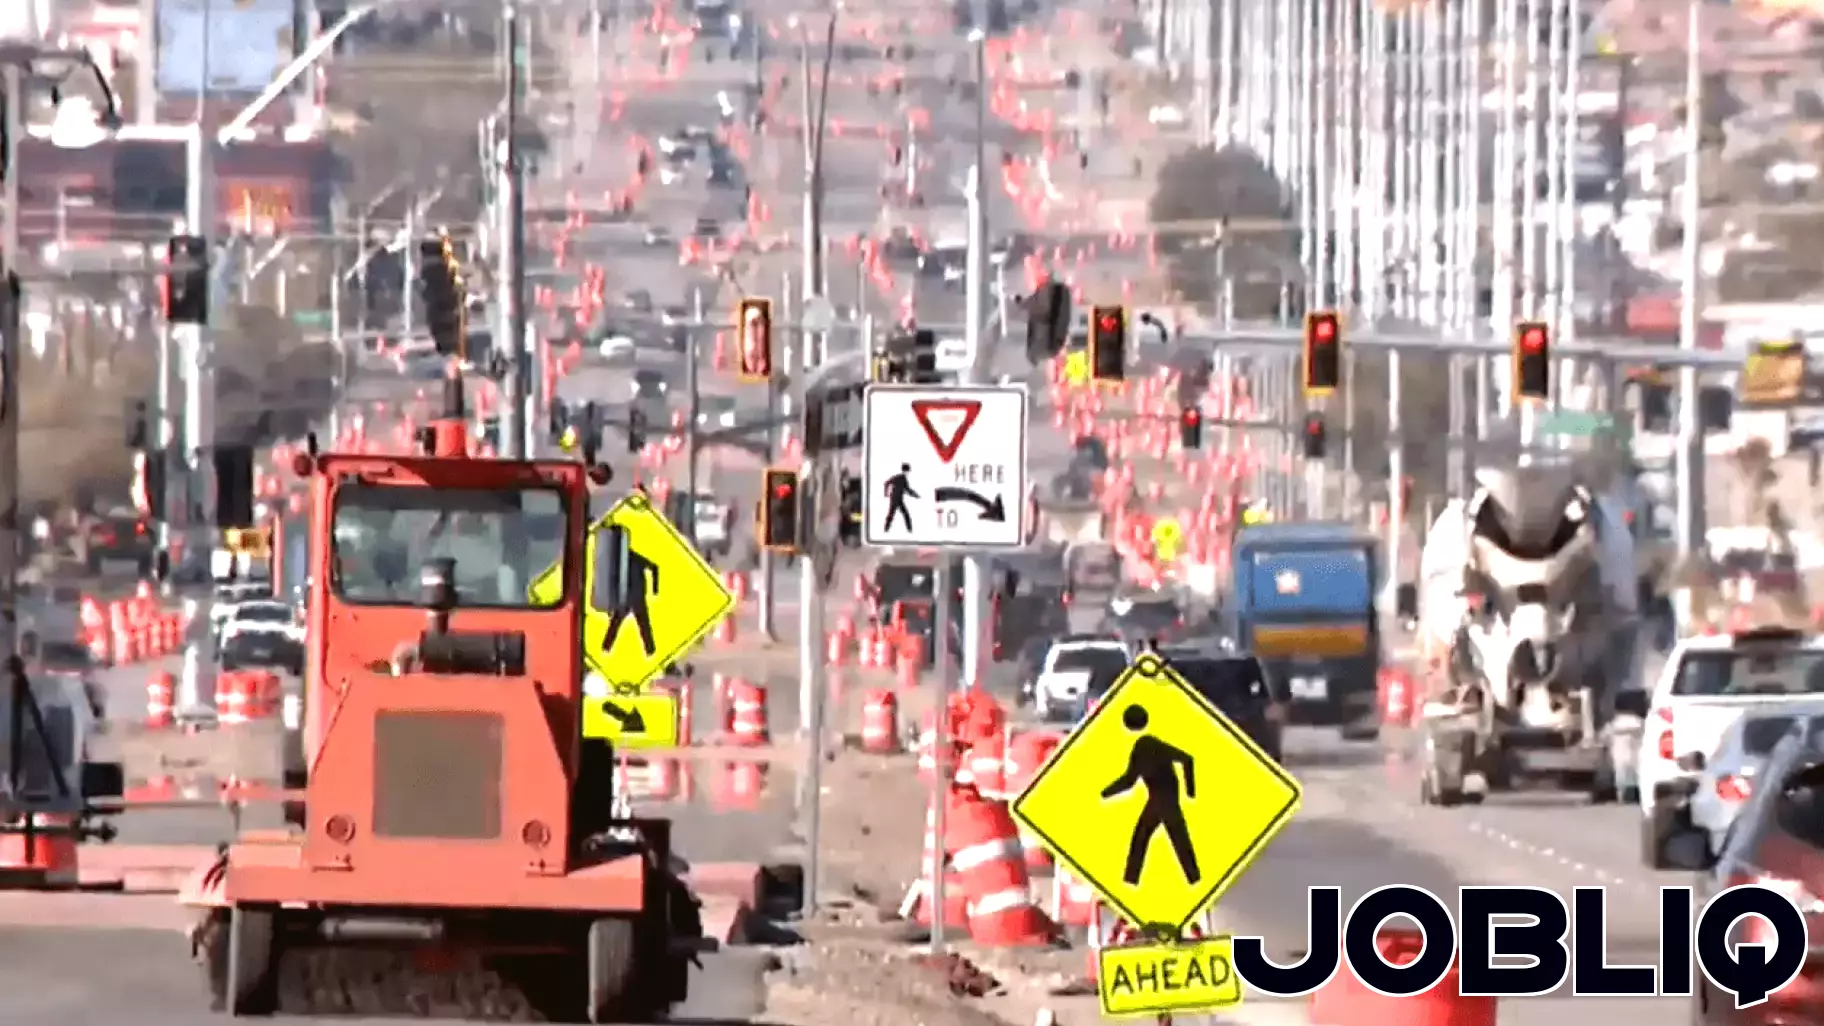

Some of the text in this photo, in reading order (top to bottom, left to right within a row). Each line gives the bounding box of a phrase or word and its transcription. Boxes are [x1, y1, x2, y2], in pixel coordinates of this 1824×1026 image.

[954, 463, 1005, 484] HERE
[936, 508, 959, 528] TO
[1111, 955, 1230, 996] AHEAD
